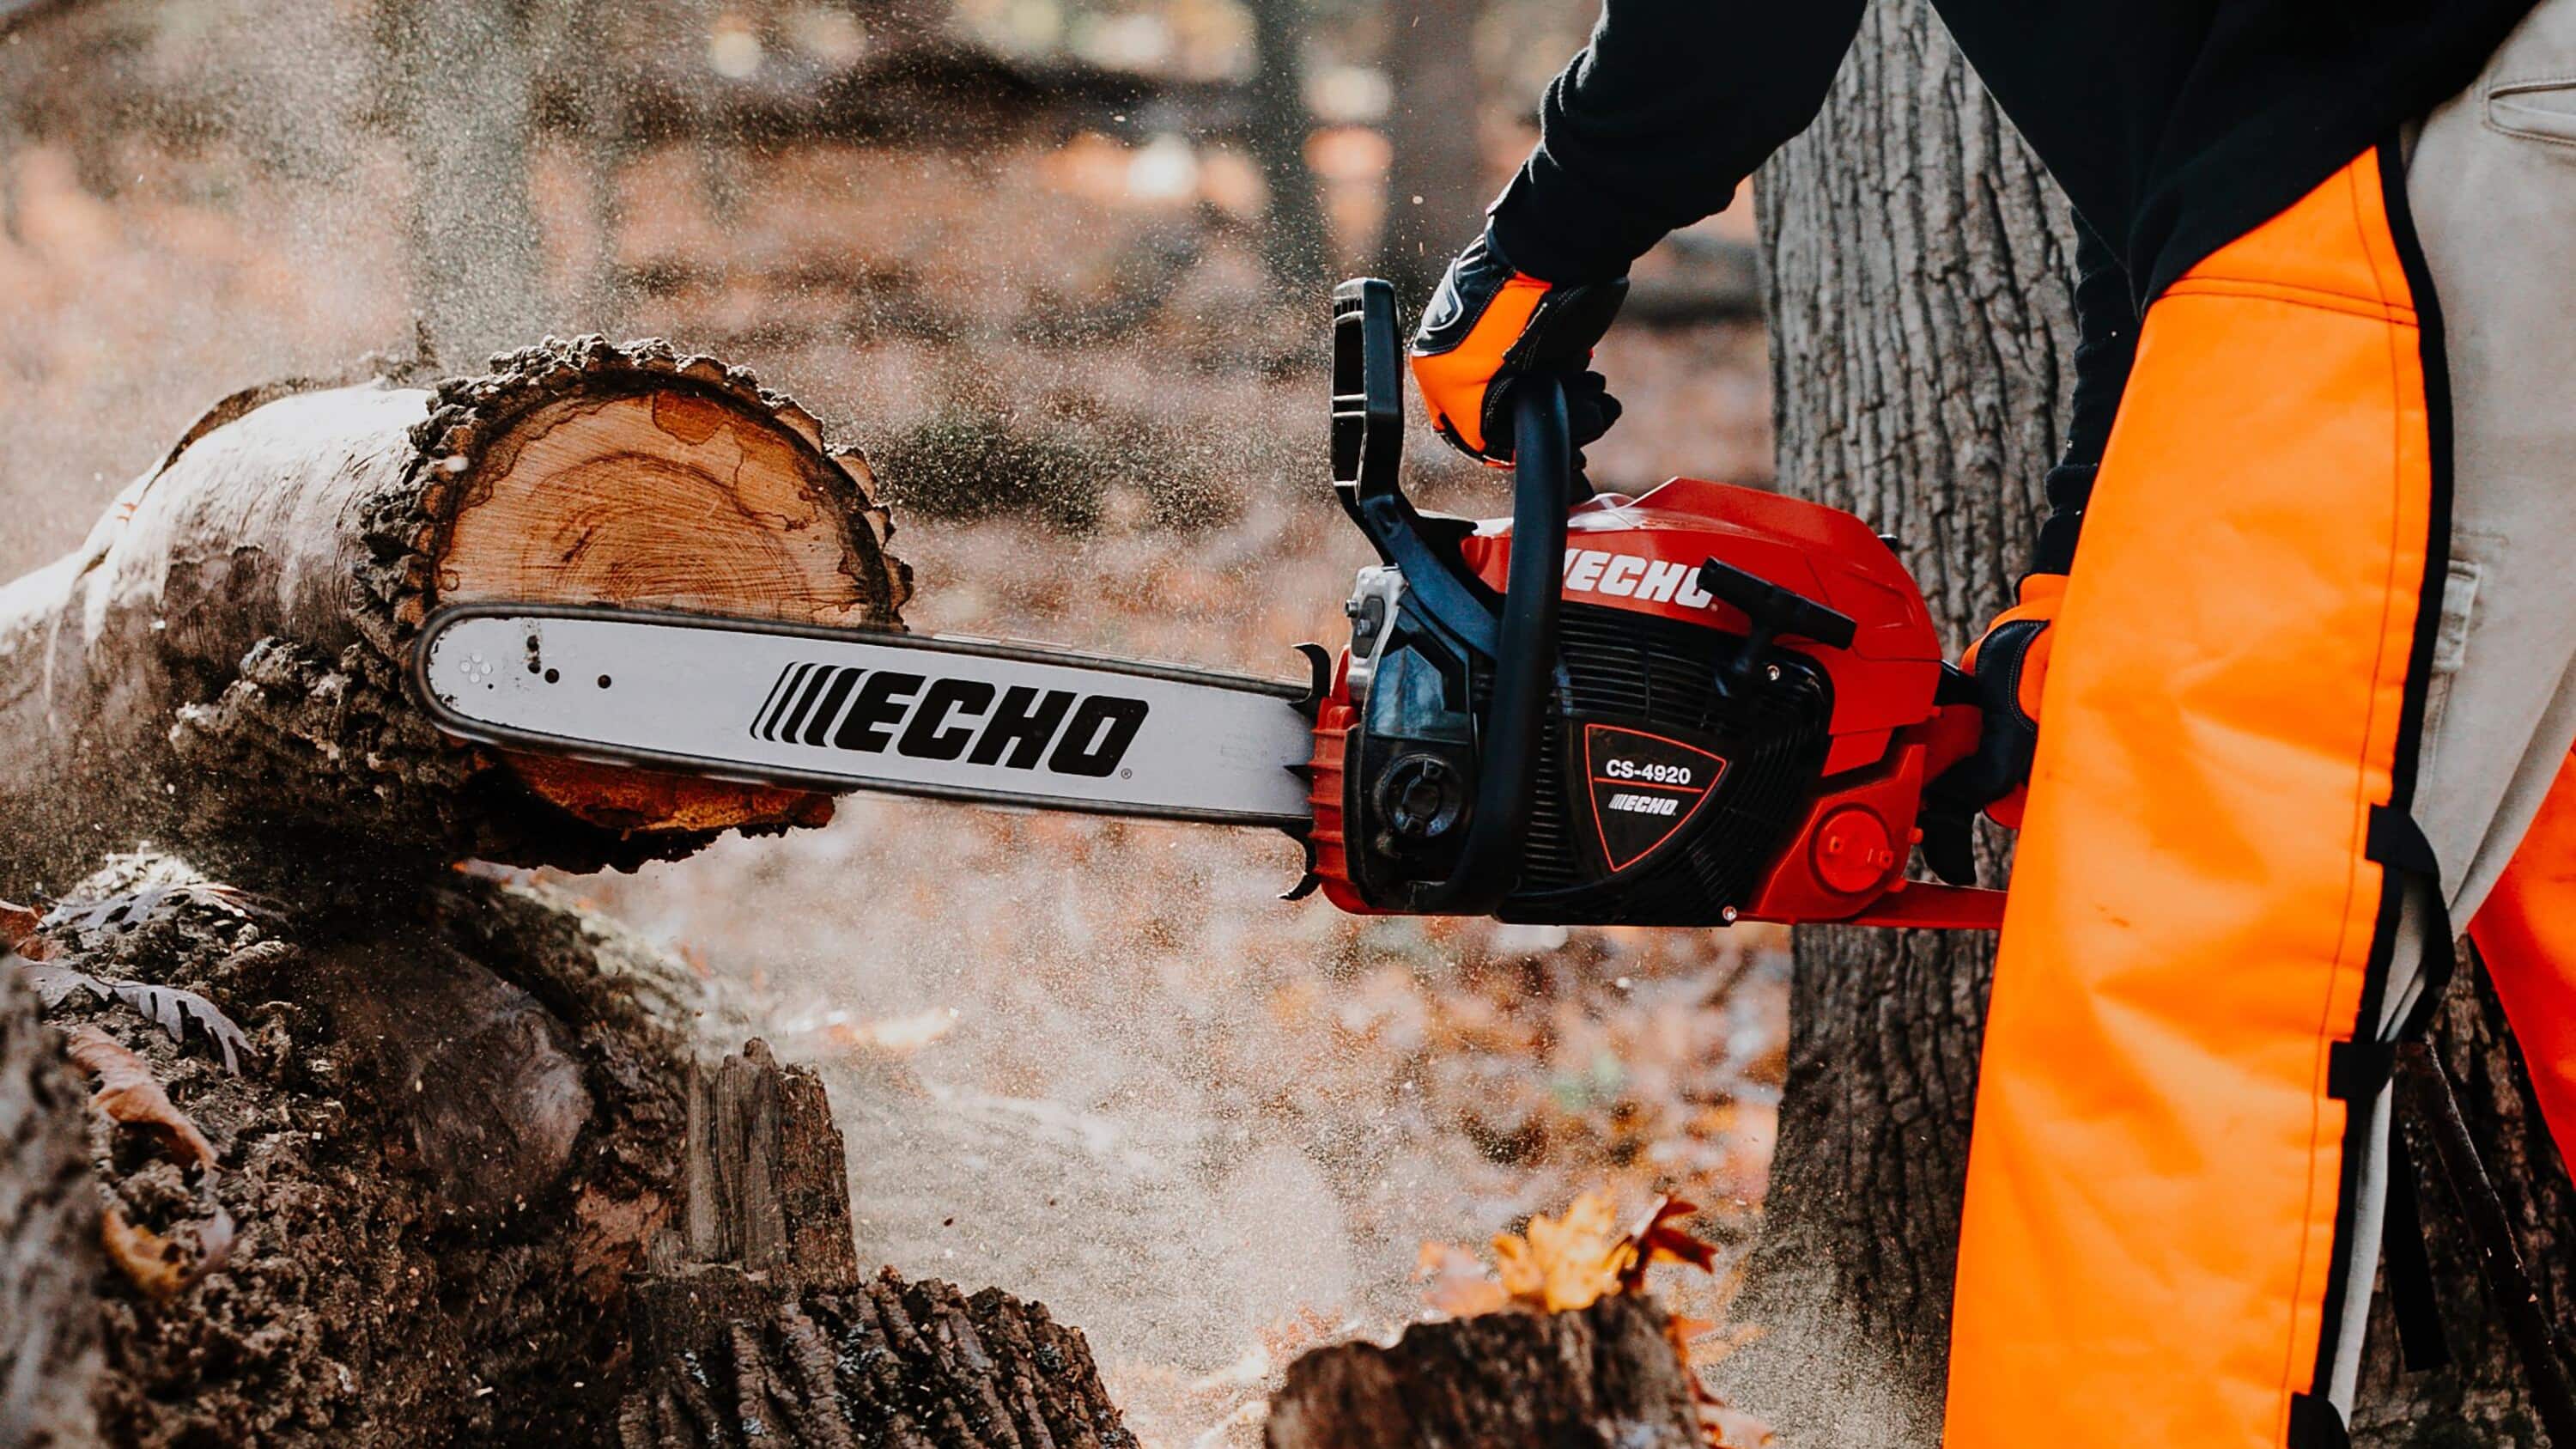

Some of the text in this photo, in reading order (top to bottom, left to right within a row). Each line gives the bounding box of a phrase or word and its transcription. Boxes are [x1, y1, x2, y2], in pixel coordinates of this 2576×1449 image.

[1565, 550, 1713, 609] ECHO
[833, 671, 1150, 777] ECHO
[1606, 759, 1692, 785] CS-4920
[1623, 795, 1679, 816] ECHO
